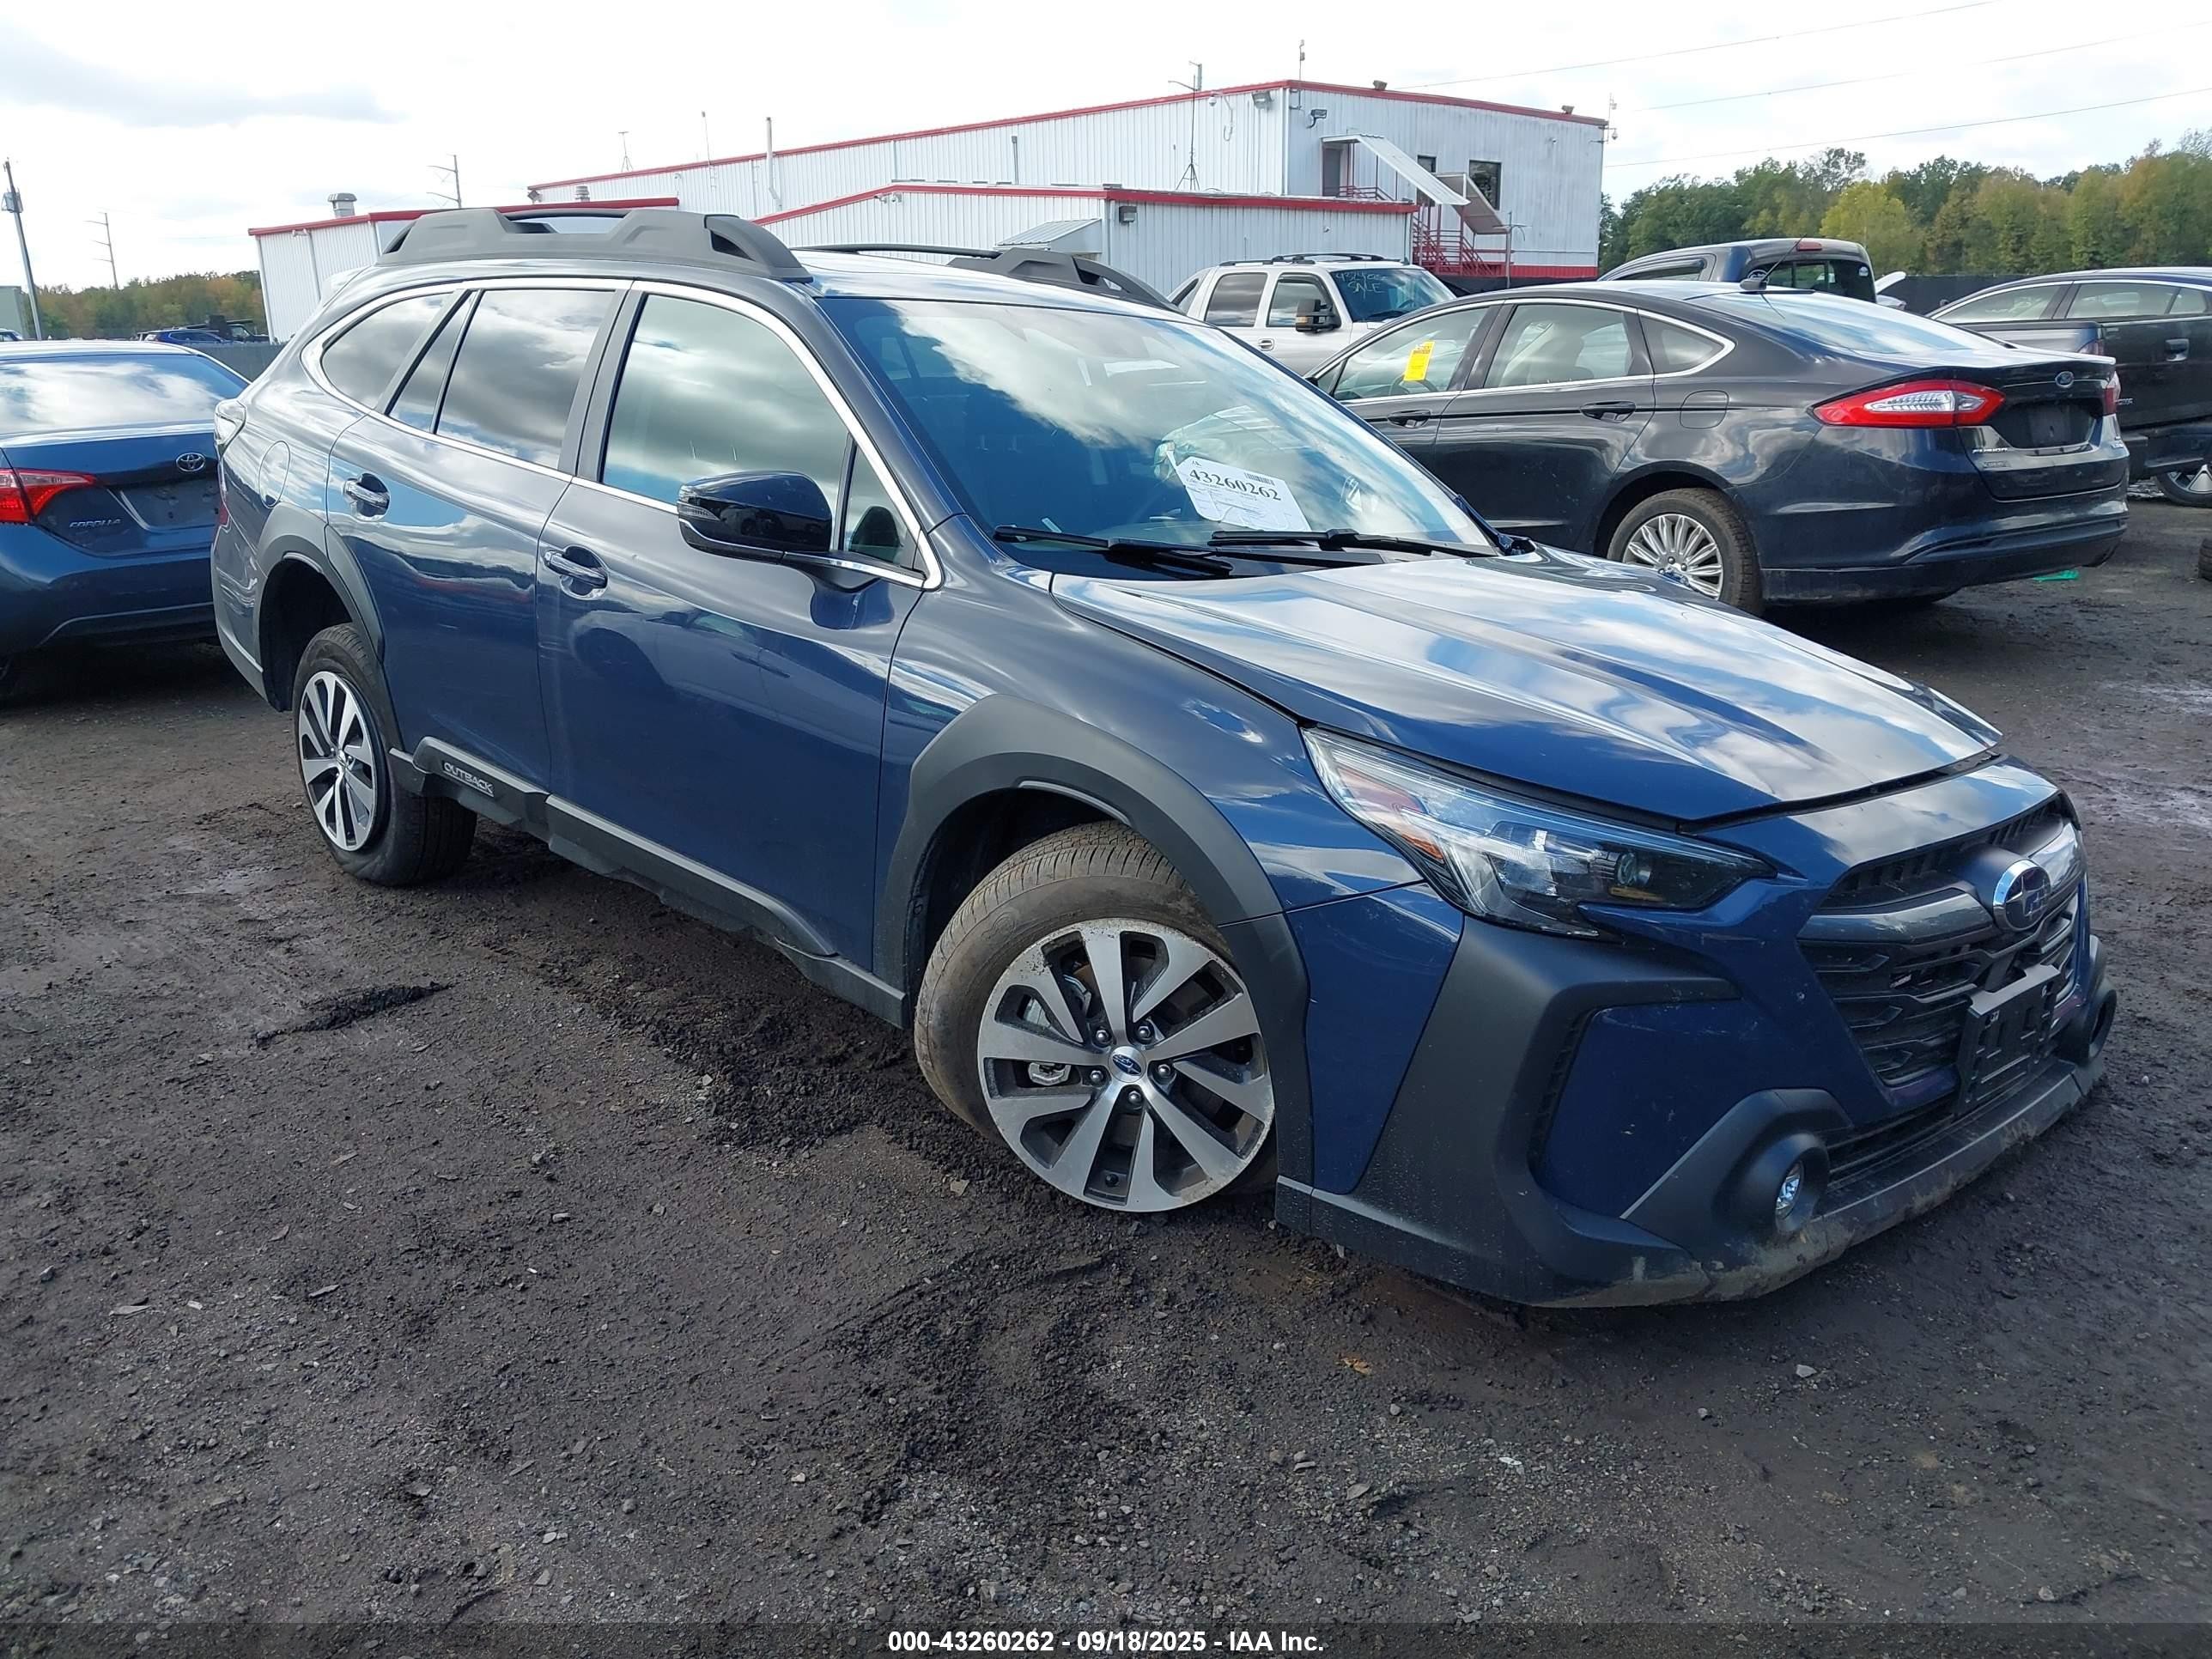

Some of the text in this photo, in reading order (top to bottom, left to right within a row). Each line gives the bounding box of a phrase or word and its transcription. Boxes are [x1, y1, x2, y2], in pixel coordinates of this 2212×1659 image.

[1188, 469, 1282, 501] 43260262
[69, 519, 122, 528] COROLLA
[443, 762, 494, 795] OUTBACK
